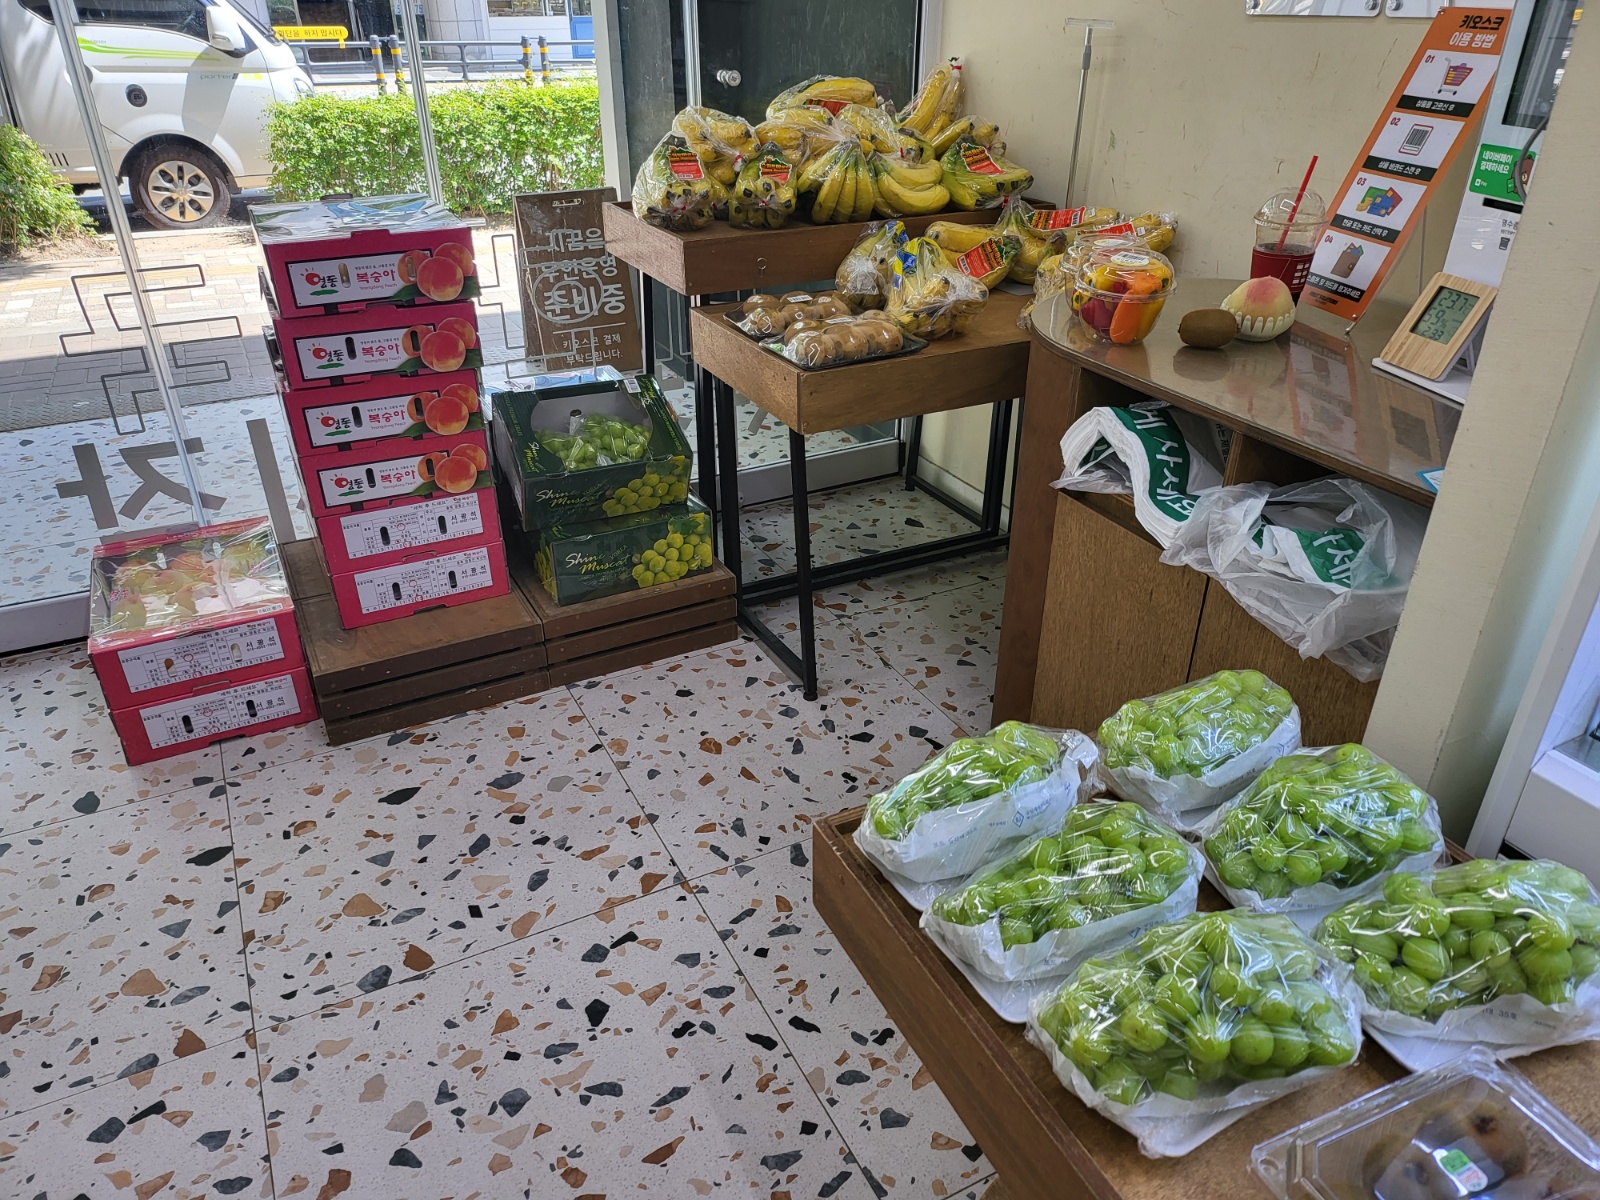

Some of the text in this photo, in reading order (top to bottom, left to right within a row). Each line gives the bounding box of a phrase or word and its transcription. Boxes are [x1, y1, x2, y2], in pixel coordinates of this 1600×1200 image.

[1459, 15, 1504, 30] 키오스크
[1449, 32, 1498, 48] 이용 방법
[1424, 54, 1436, 64] 01
[1390, 117, 1401, 126] 02
[1483, 150, 1513, 164] 네이버페이
[1480, 160, 1510, 174] 결제하세요
[1357, 177, 1367, 186] 03
[1362, 224, 1373, 233] 카드
[1325, 235, 1333, 243] 04
[356, 269, 396, 283] 복숭아
[603, 333, 622, 346] 결제
[362, 343, 399, 357] 복숭아
[368, 410, 406, 423] 복숭아
[380, 470, 416, 483] 복숭아
[536, 490, 578, 502] Shine
[549, 492, 604, 507] Muscat
[566, 552, 605, 568] Shine
[579, 554, 630, 574] Muscat
